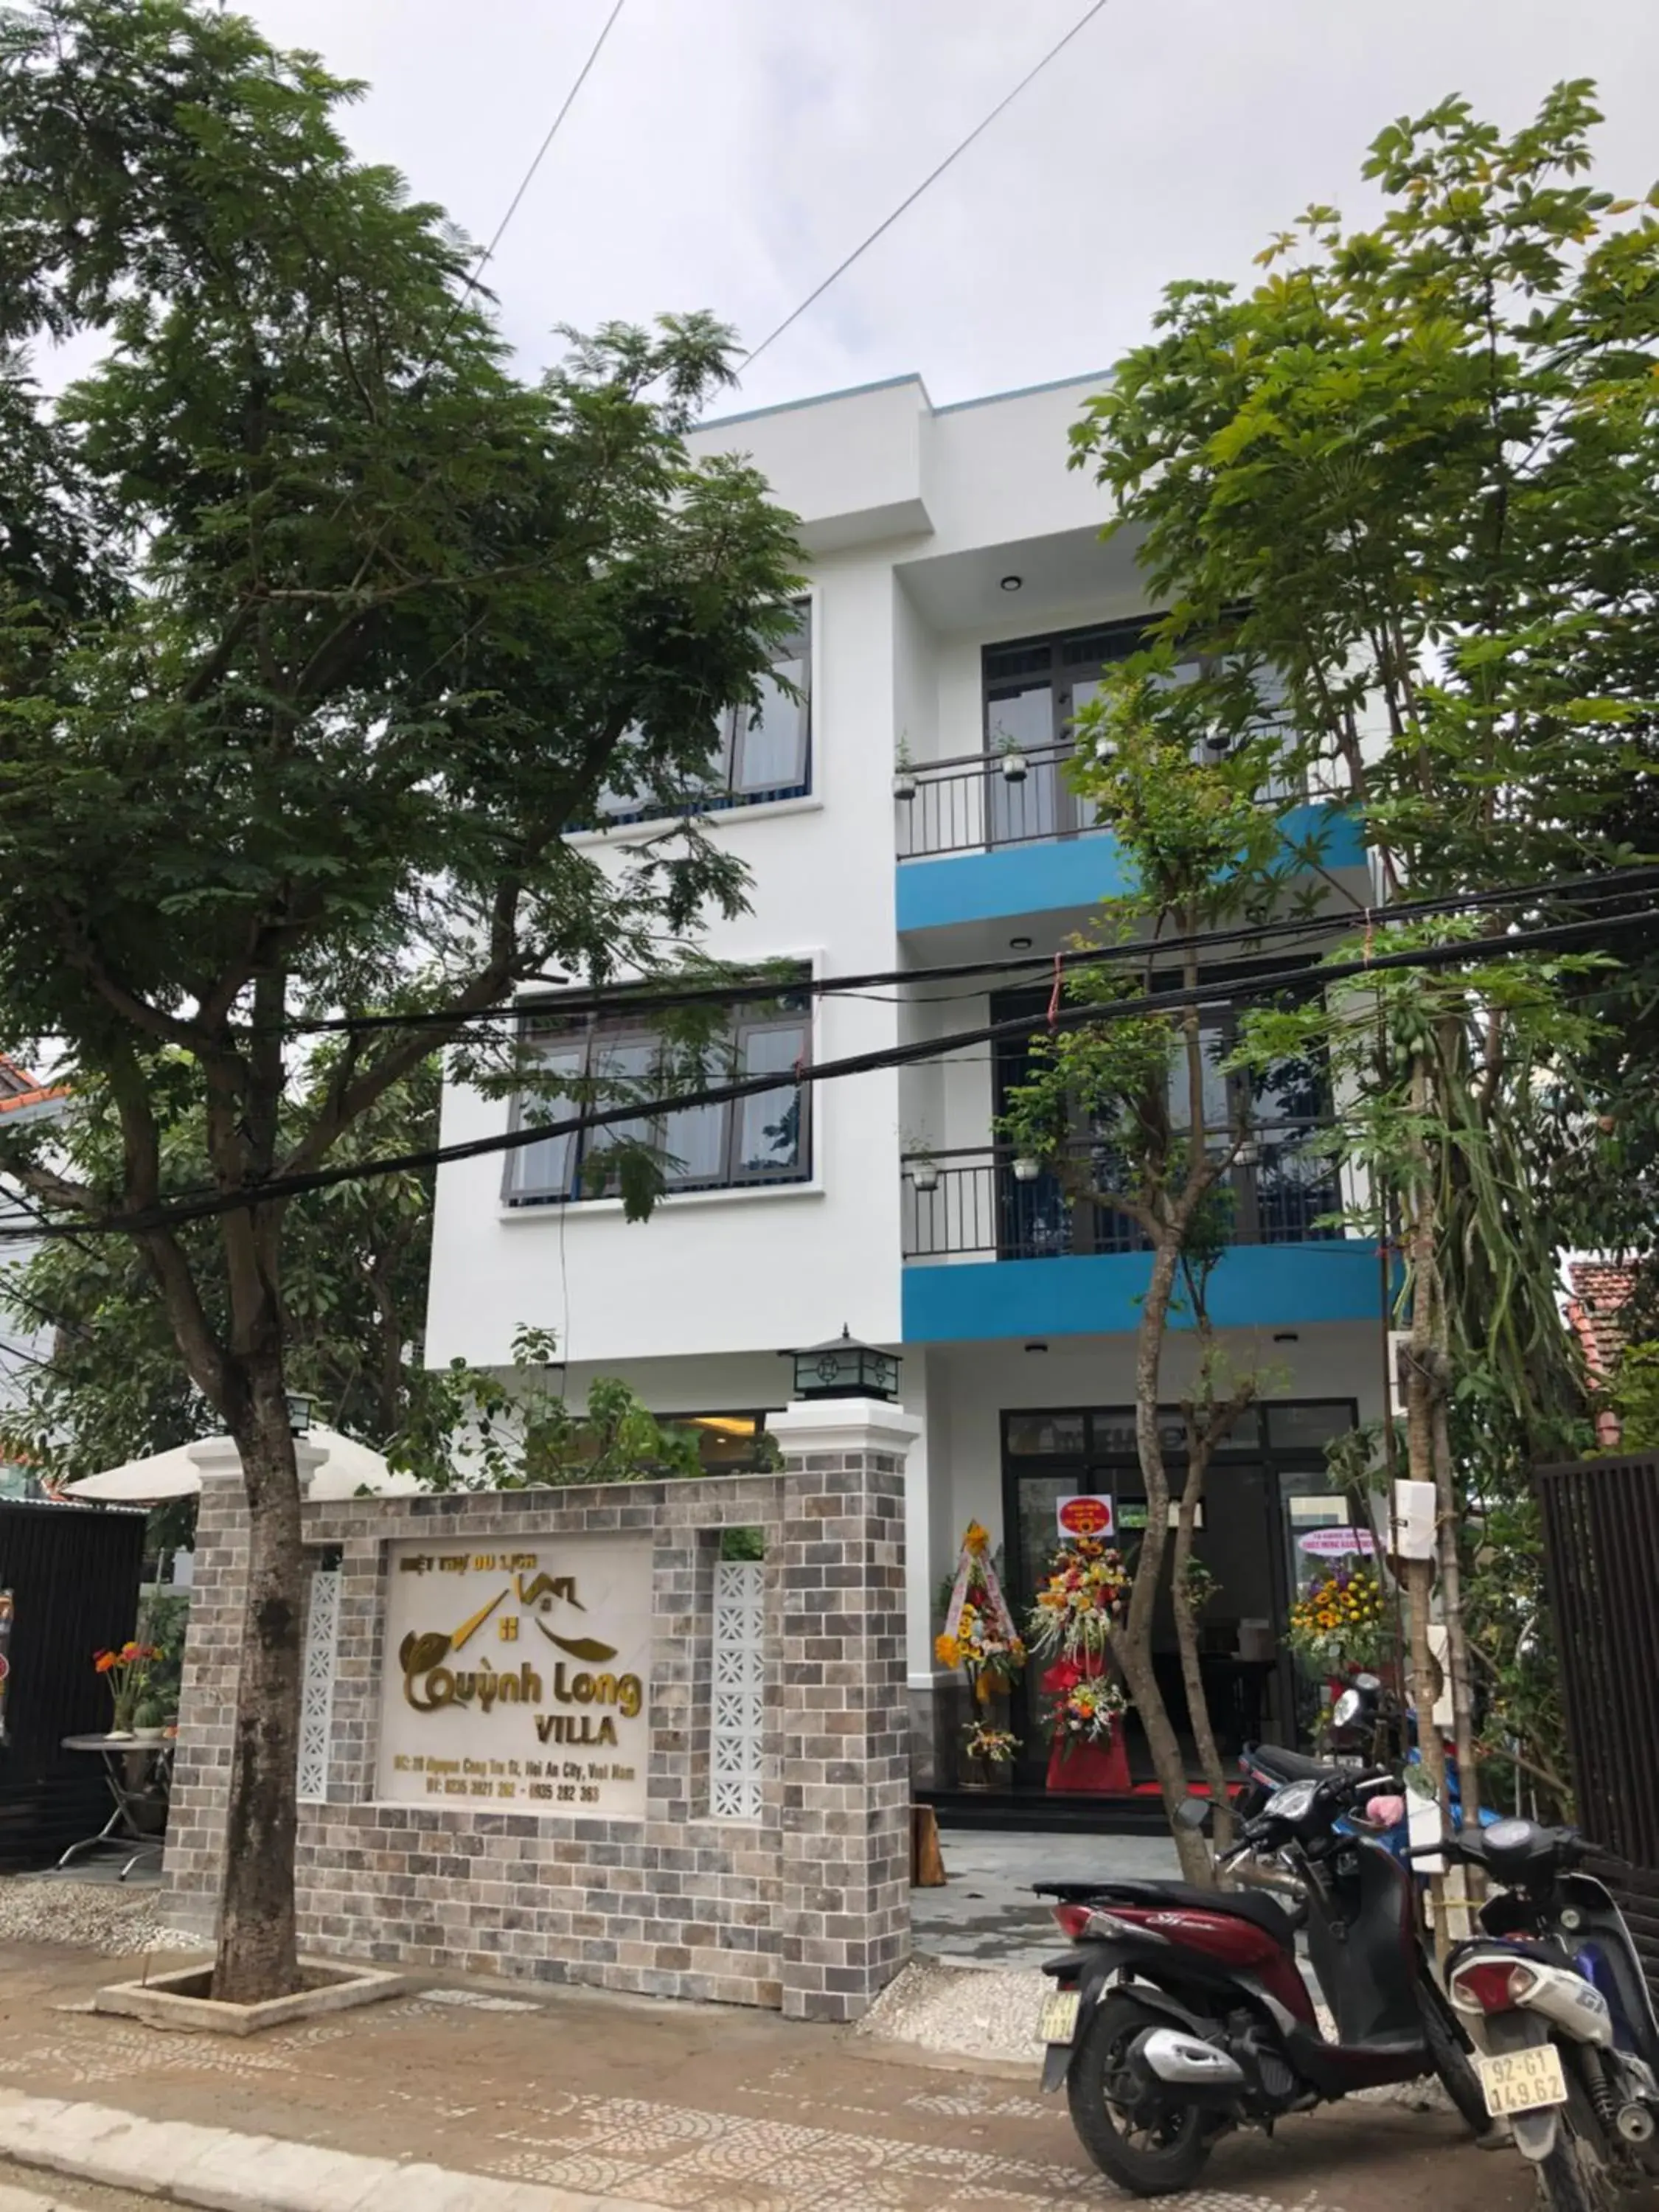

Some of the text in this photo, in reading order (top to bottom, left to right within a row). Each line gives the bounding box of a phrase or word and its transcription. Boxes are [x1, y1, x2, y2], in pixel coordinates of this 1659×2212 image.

[403, 1655, 644, 1718] Quỳnh Long
[534, 1714, 619, 1747] VILLA
[1492, 2050, 1548, 2084] 92-G1
[1489, 2074, 1564, 2112] 149.62
